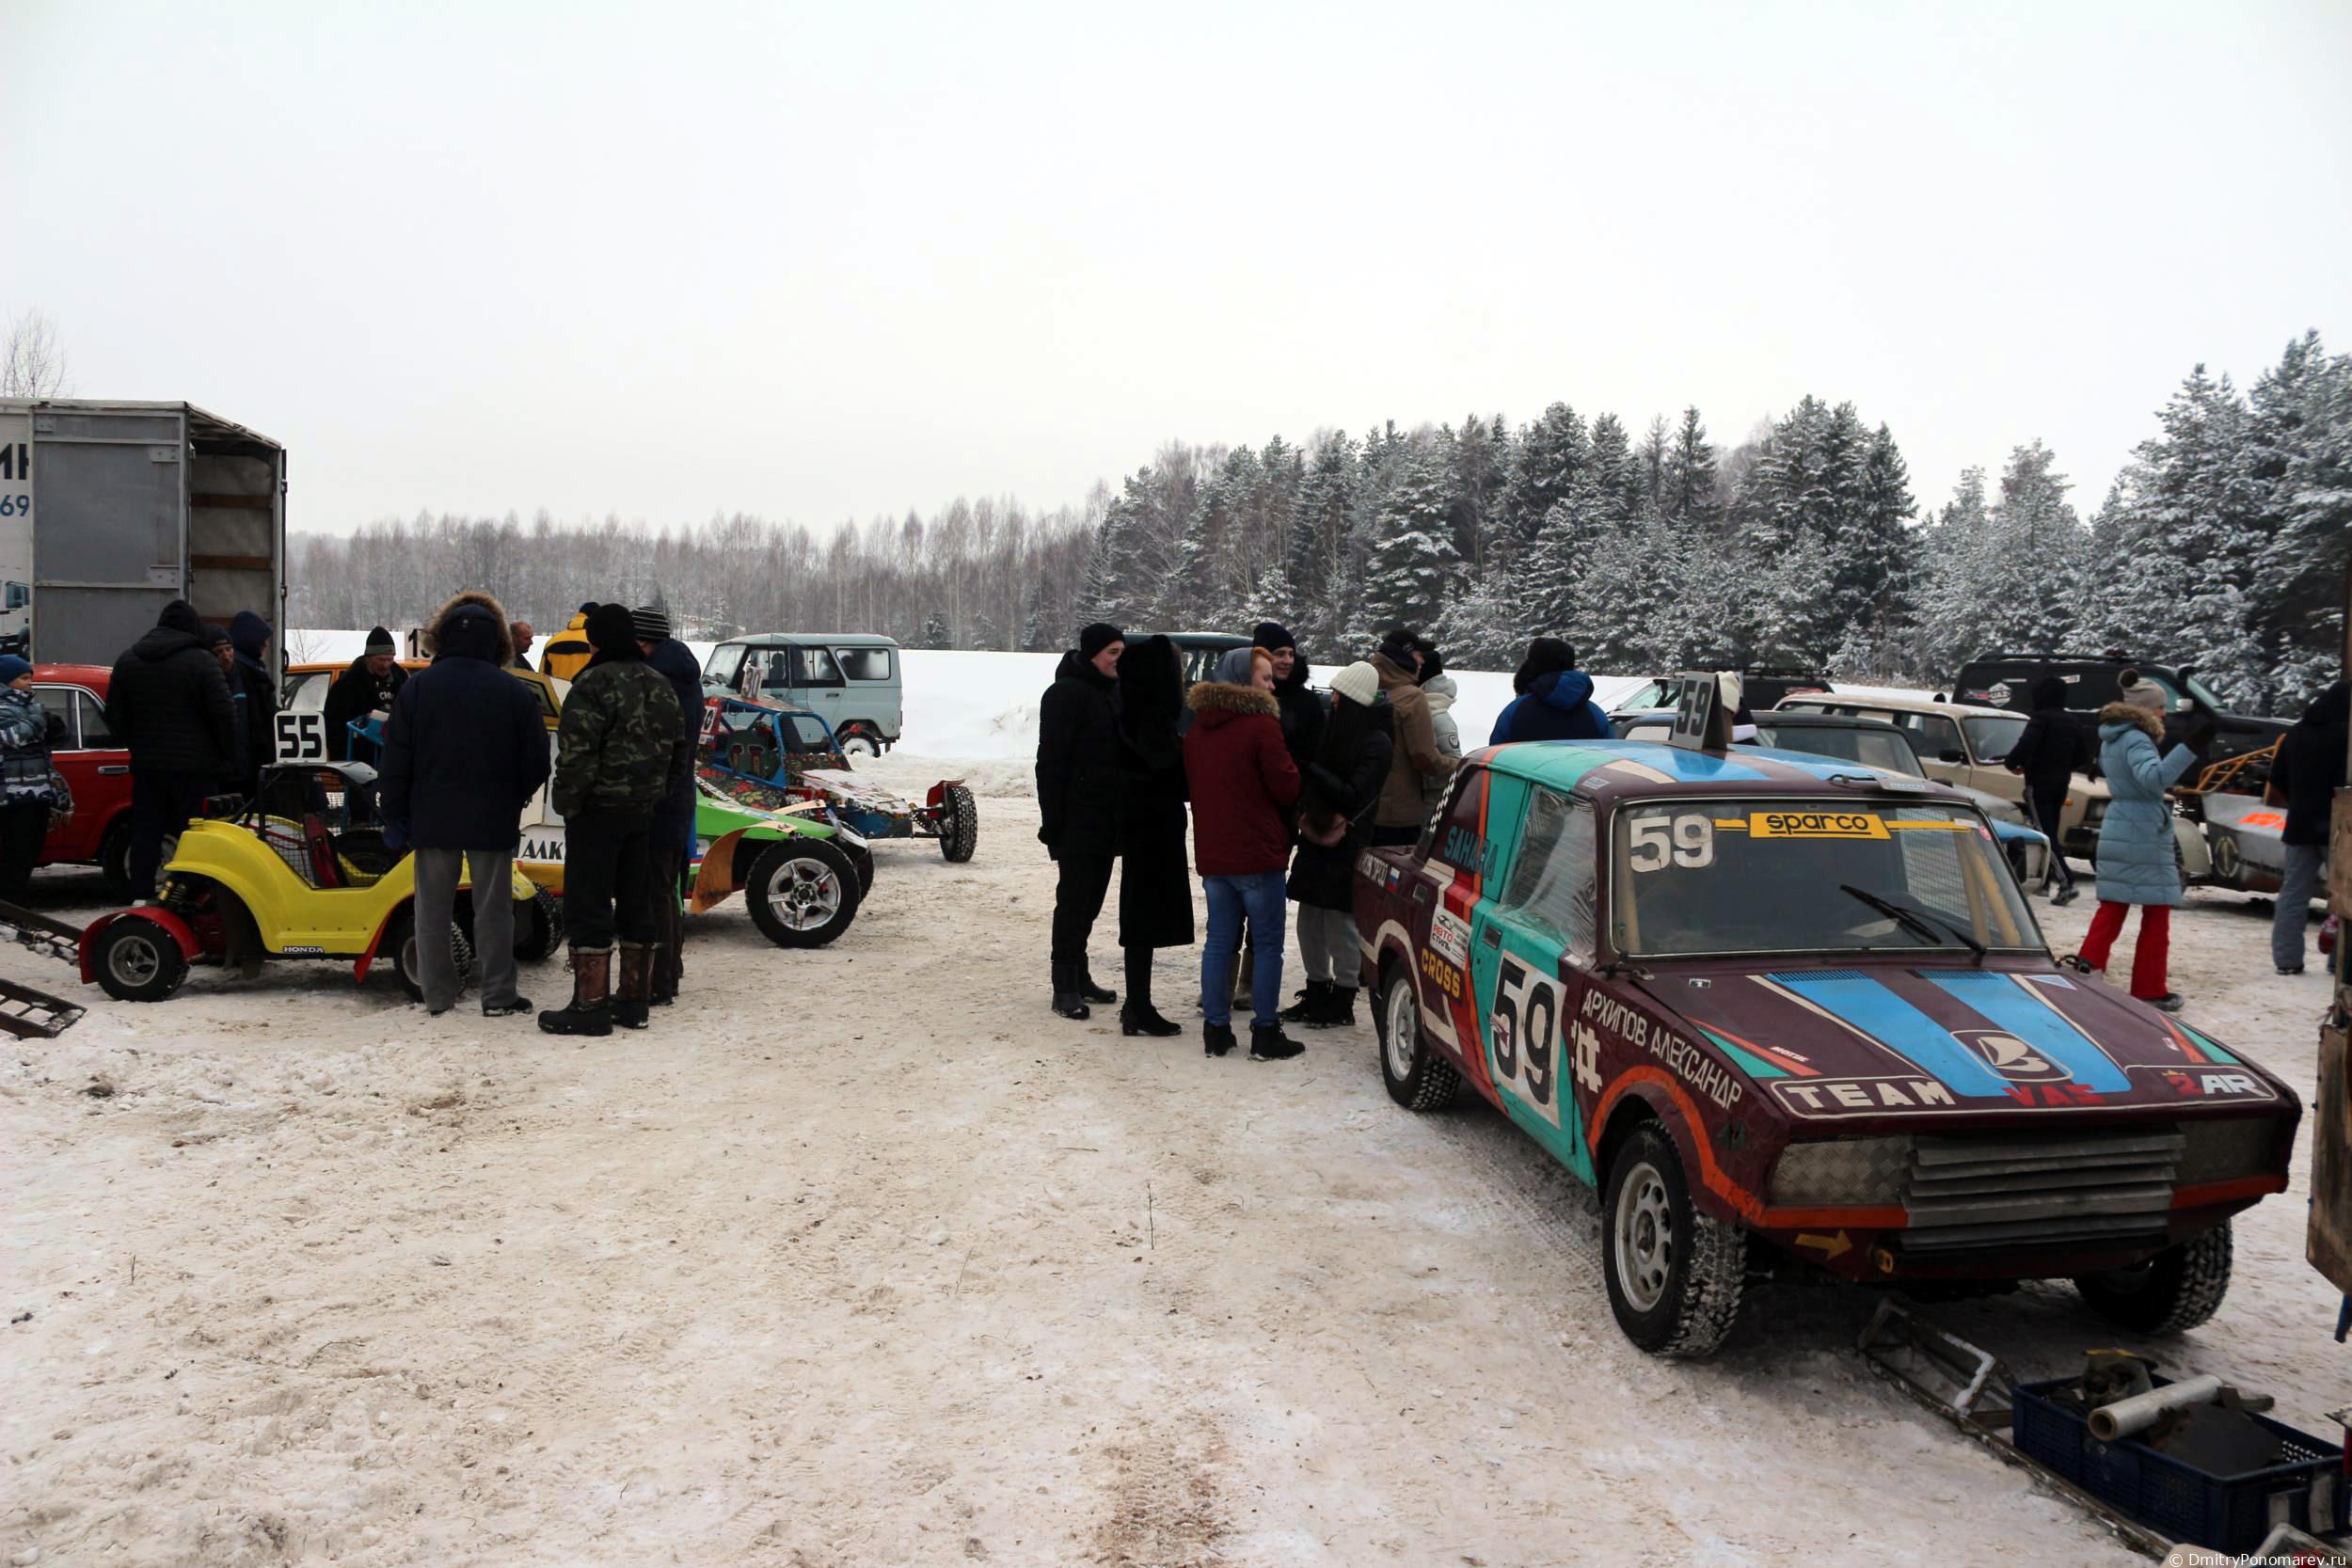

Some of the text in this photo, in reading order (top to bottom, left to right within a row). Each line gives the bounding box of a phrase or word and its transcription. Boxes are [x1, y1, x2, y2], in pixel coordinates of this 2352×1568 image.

[1676, 680, 1711, 736] 59
[277, 716, 322, 758] 55
[1630, 814, 1868, 872] 59 sparco
[1422, 947, 1460, 998] CROSS
[1493, 957, 1555, 1105] 59
[1581, 989, 1741, 1110] АРХИПОВ АЛЕКСАНДР
[1785, 1082, 1956, 1108] TEAM
